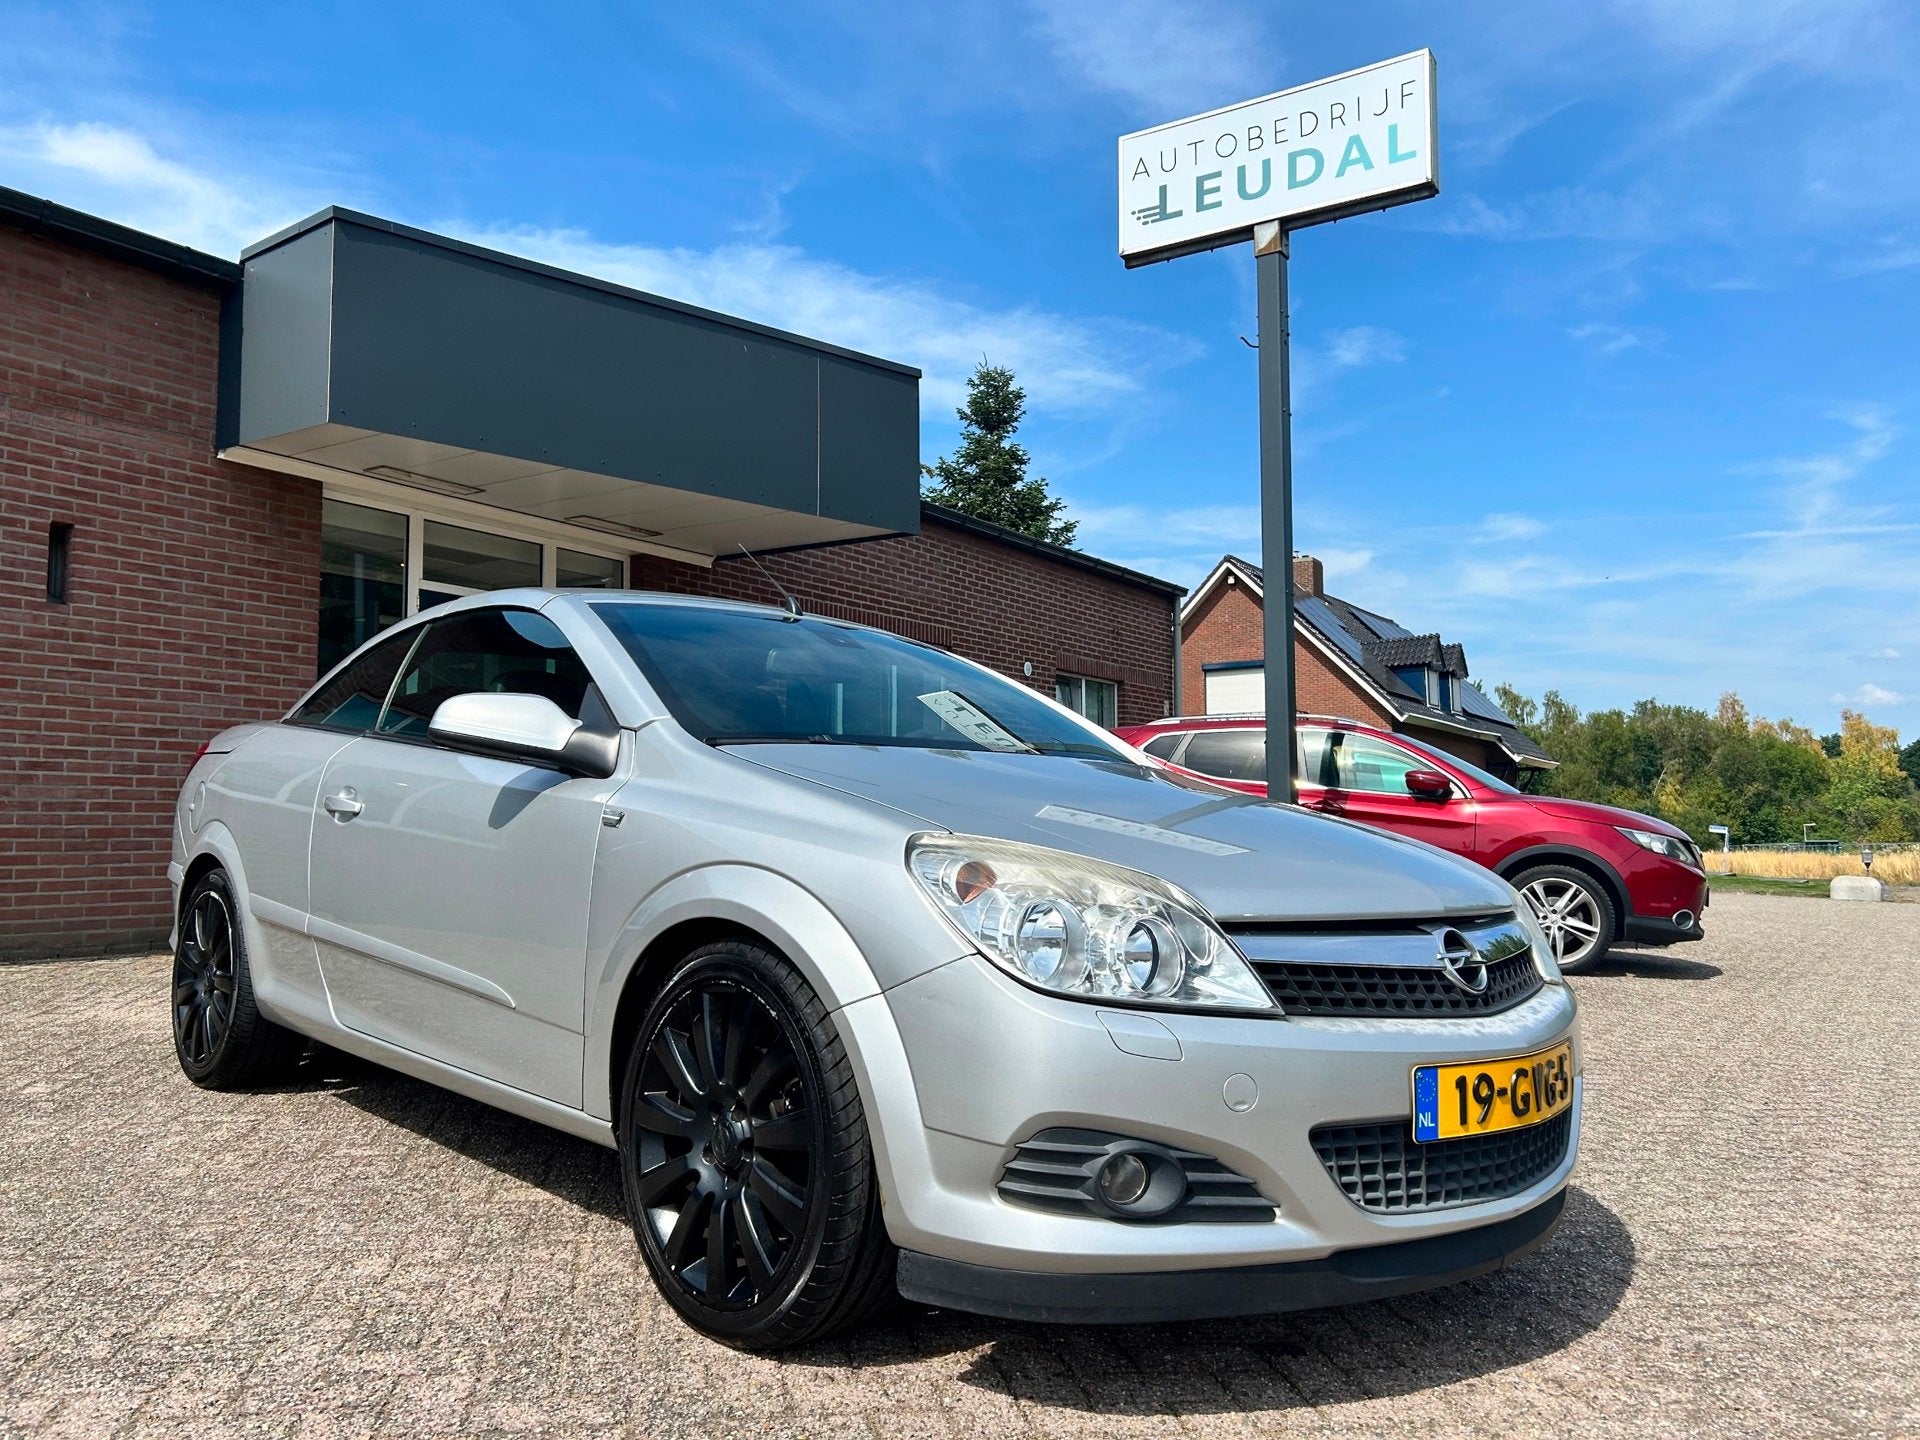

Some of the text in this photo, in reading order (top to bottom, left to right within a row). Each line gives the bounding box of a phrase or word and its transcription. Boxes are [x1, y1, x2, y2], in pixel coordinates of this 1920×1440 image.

[1131, 79, 1417, 182] AUTOBEDRIJF
[1157, 122, 1418, 223] LEUDAL
[1418, 1111, 1436, 1128] NL
